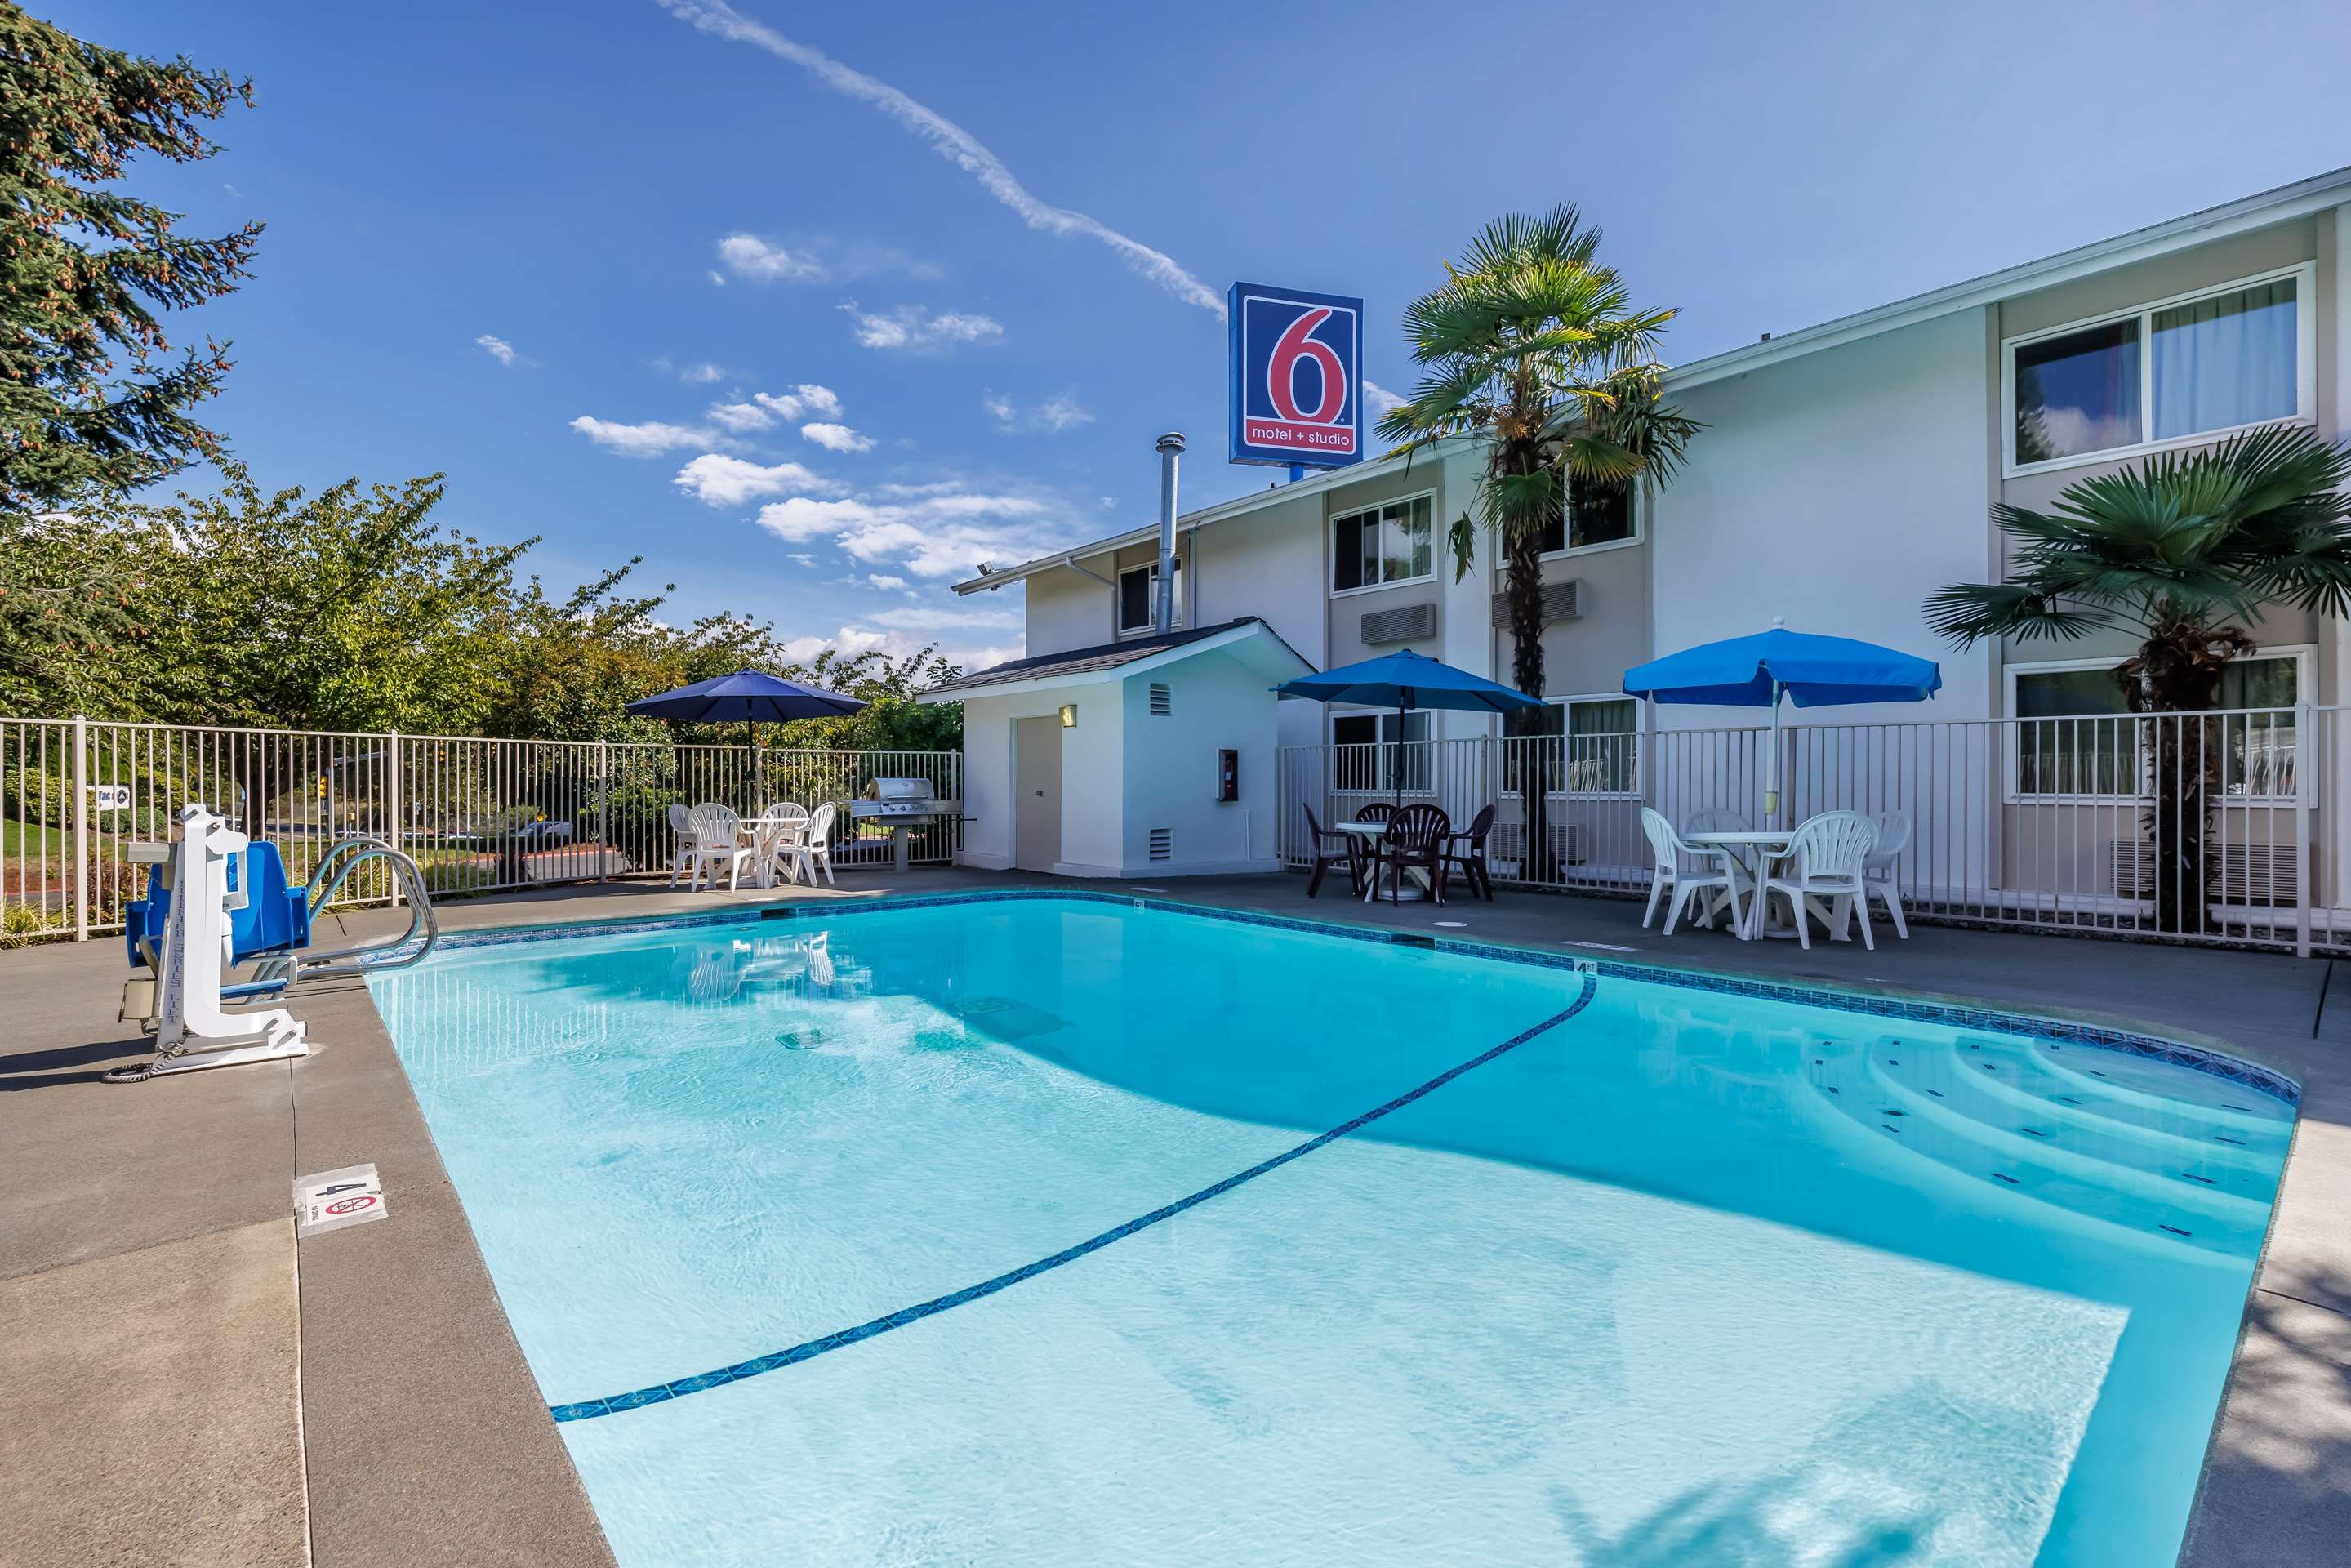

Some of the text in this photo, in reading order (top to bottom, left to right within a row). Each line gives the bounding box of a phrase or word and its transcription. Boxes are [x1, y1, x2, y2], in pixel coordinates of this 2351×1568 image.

[1267, 307, 1347, 425] 6
[1252, 427, 1350, 446] motel + studio
[167, 993, 180, 1025] LIFT
